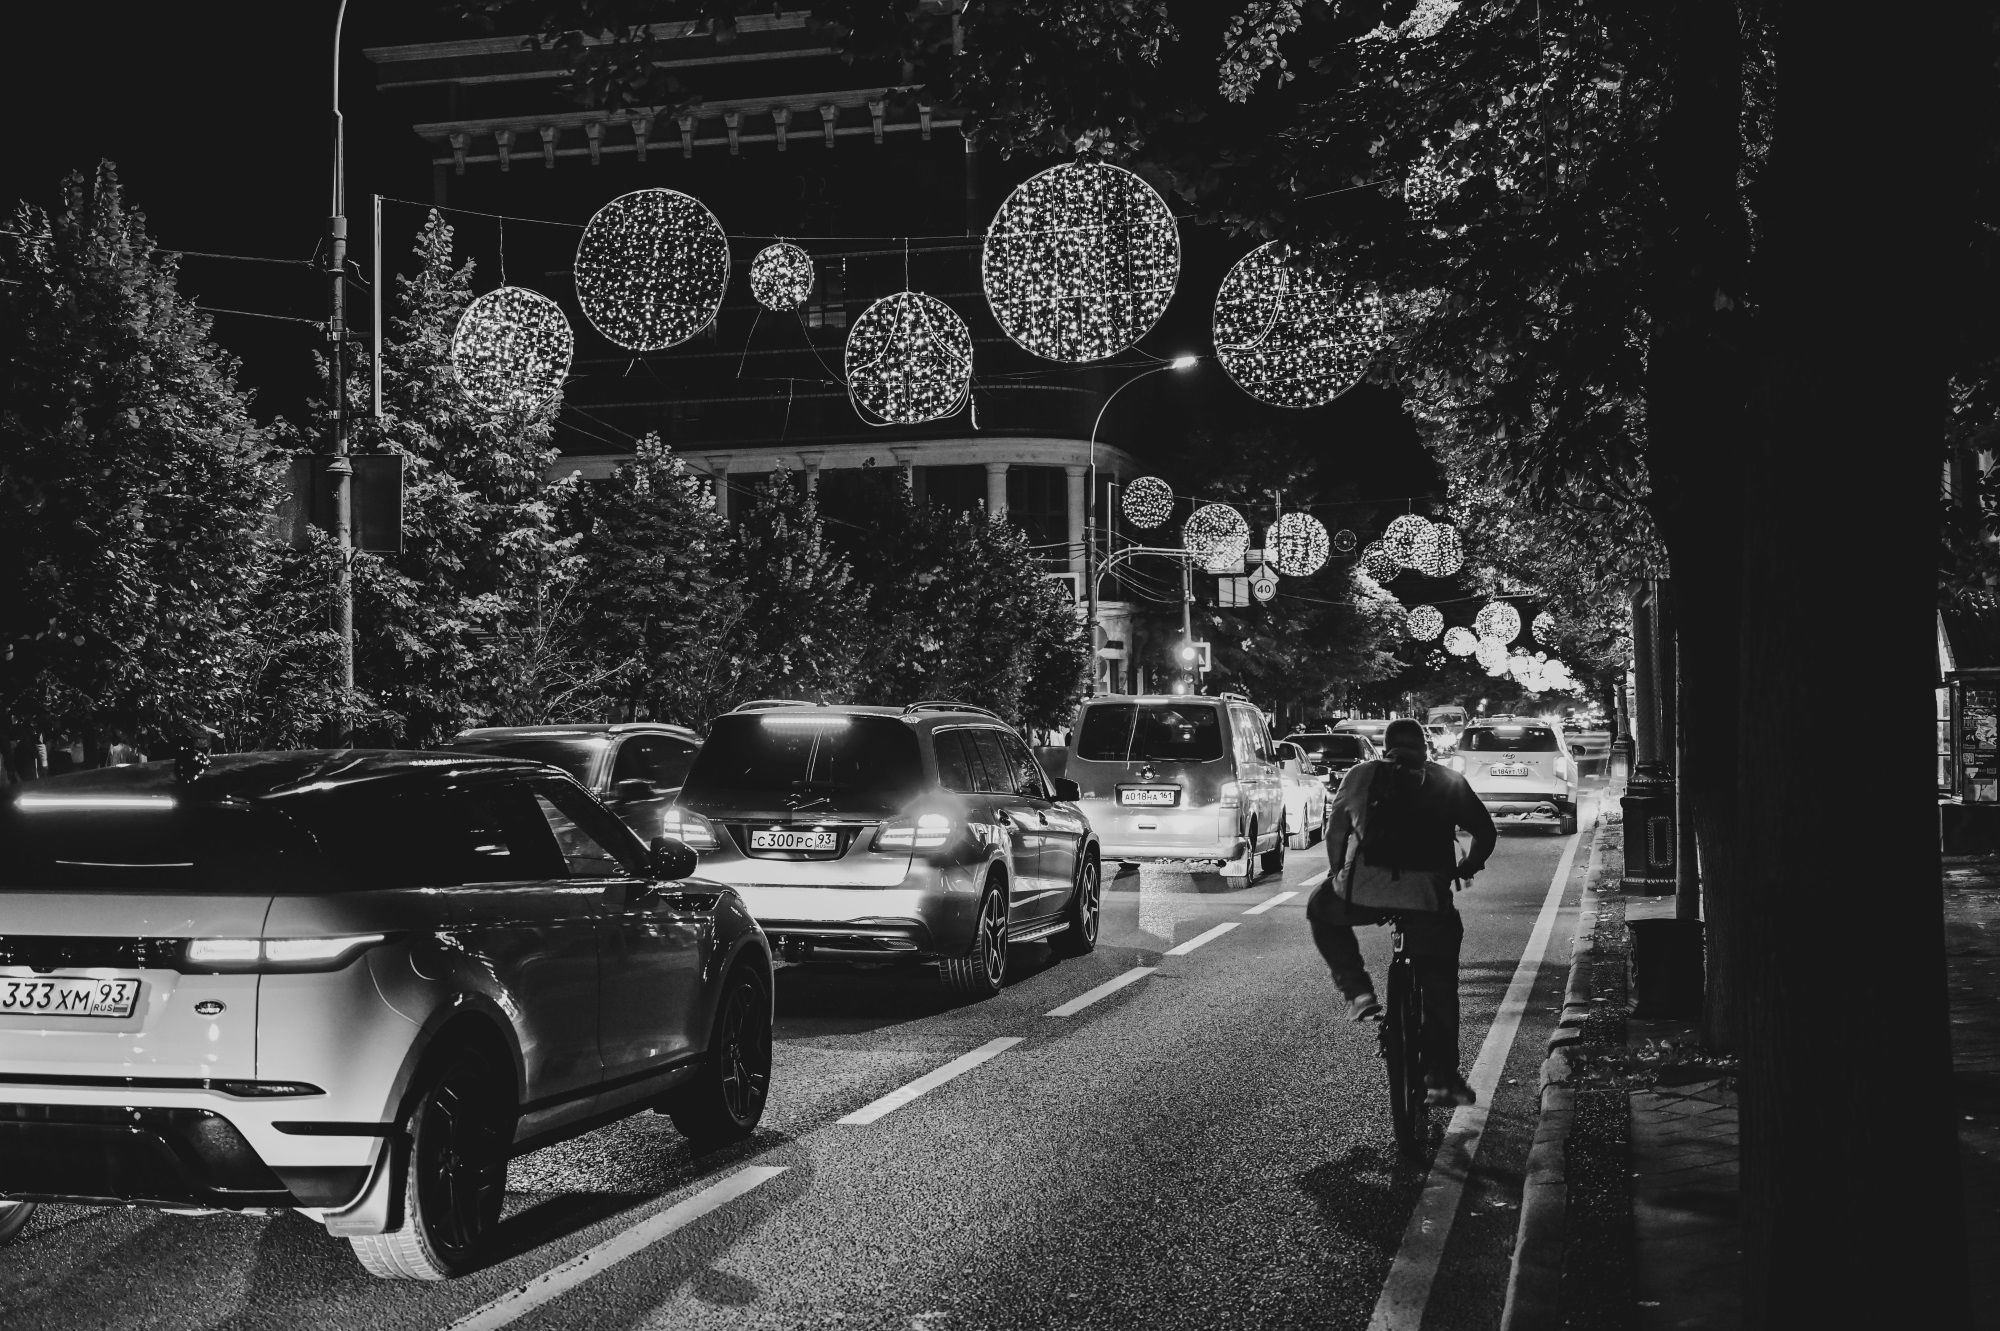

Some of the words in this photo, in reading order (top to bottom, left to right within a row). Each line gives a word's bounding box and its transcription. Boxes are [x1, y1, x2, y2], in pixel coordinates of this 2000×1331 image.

[1257, 584, 1271, 594] 40
[757, 834, 813, 848] С300РС
[817, 834, 832, 845] 93
[100, 984, 127, 1004] 93
[93, 1003, 113, 1012] RUS
